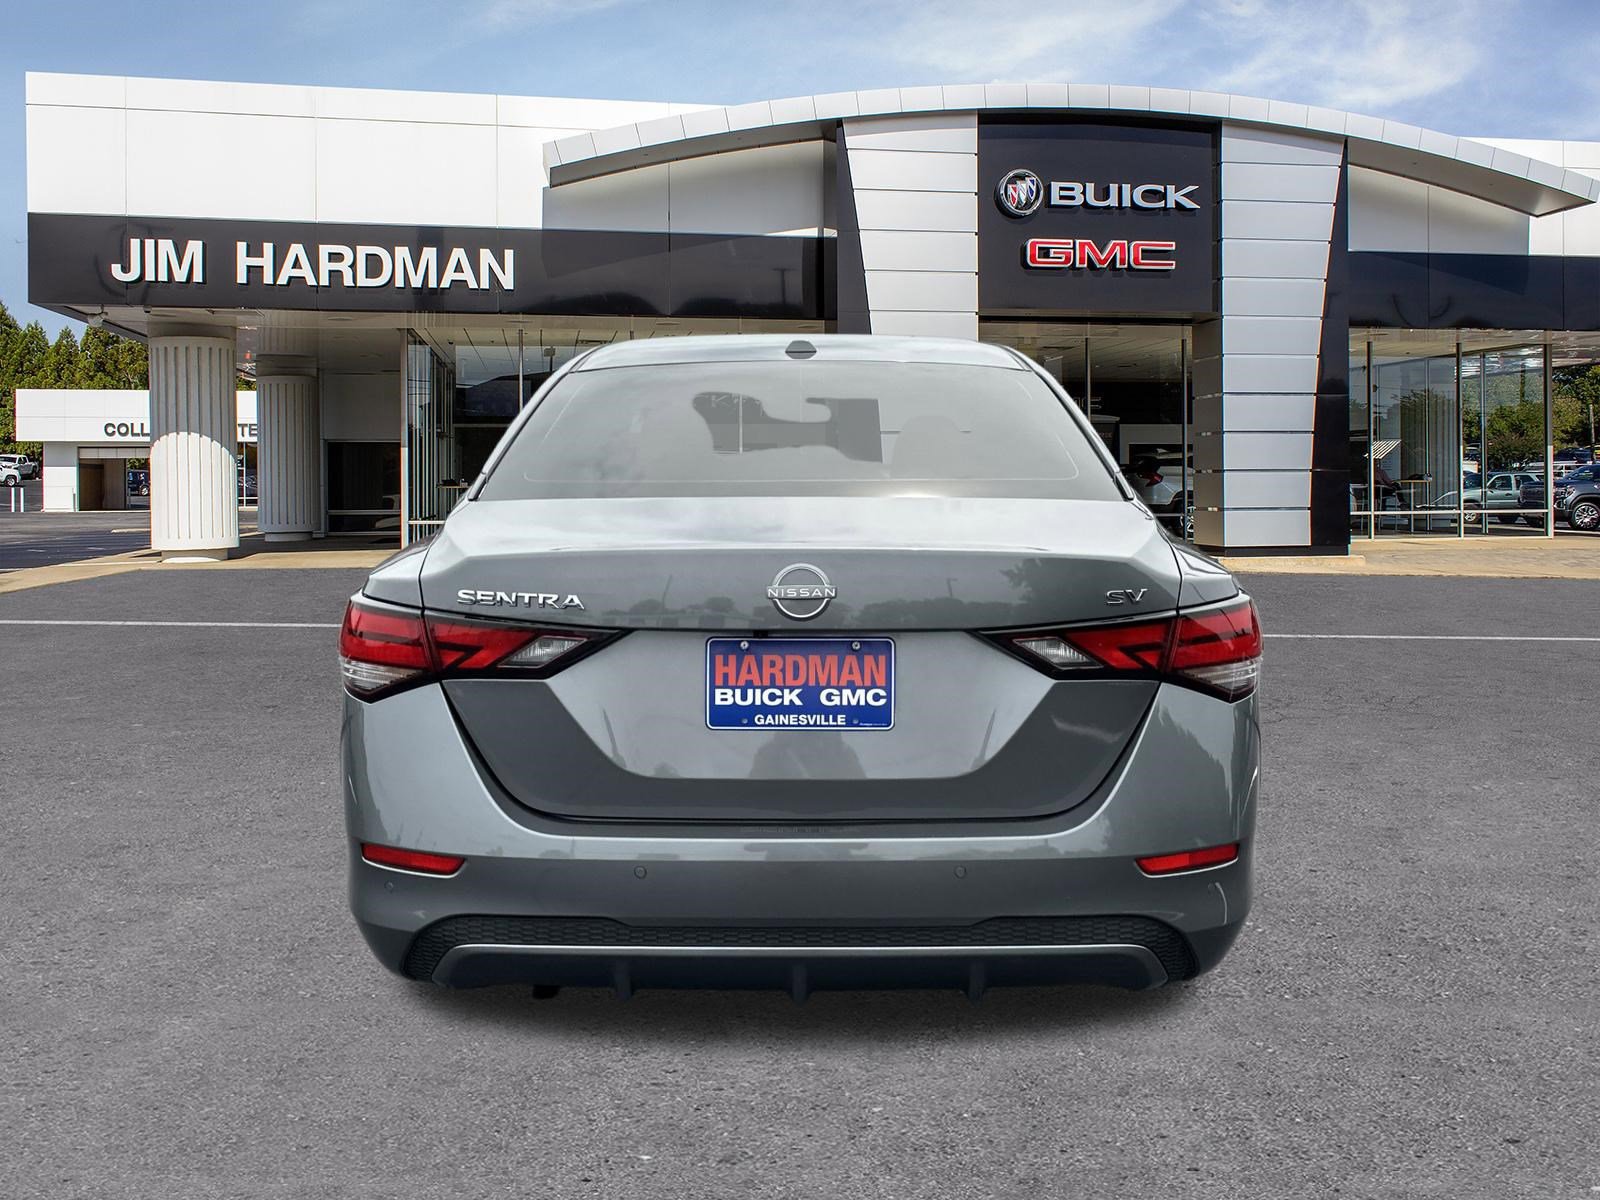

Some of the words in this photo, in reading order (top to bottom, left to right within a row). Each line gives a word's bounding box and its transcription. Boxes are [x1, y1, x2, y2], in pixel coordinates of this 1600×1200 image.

[1050, 181, 1200, 209] BUICK
[1025, 237, 1177, 270] GMC
[110, 238, 206, 284] JIM
[236, 240, 515, 291] HARDMAN
[456, 589, 585, 610] SENTRA
[767, 587, 836, 598] NISSAN
[1106, 588, 1148, 604] SV
[714, 654, 887, 687] HARDMAN
[714, 688, 804, 706] BUICK
[820, 688, 888, 707] GMC
[754, 714, 847, 726] GAINESVILLE
